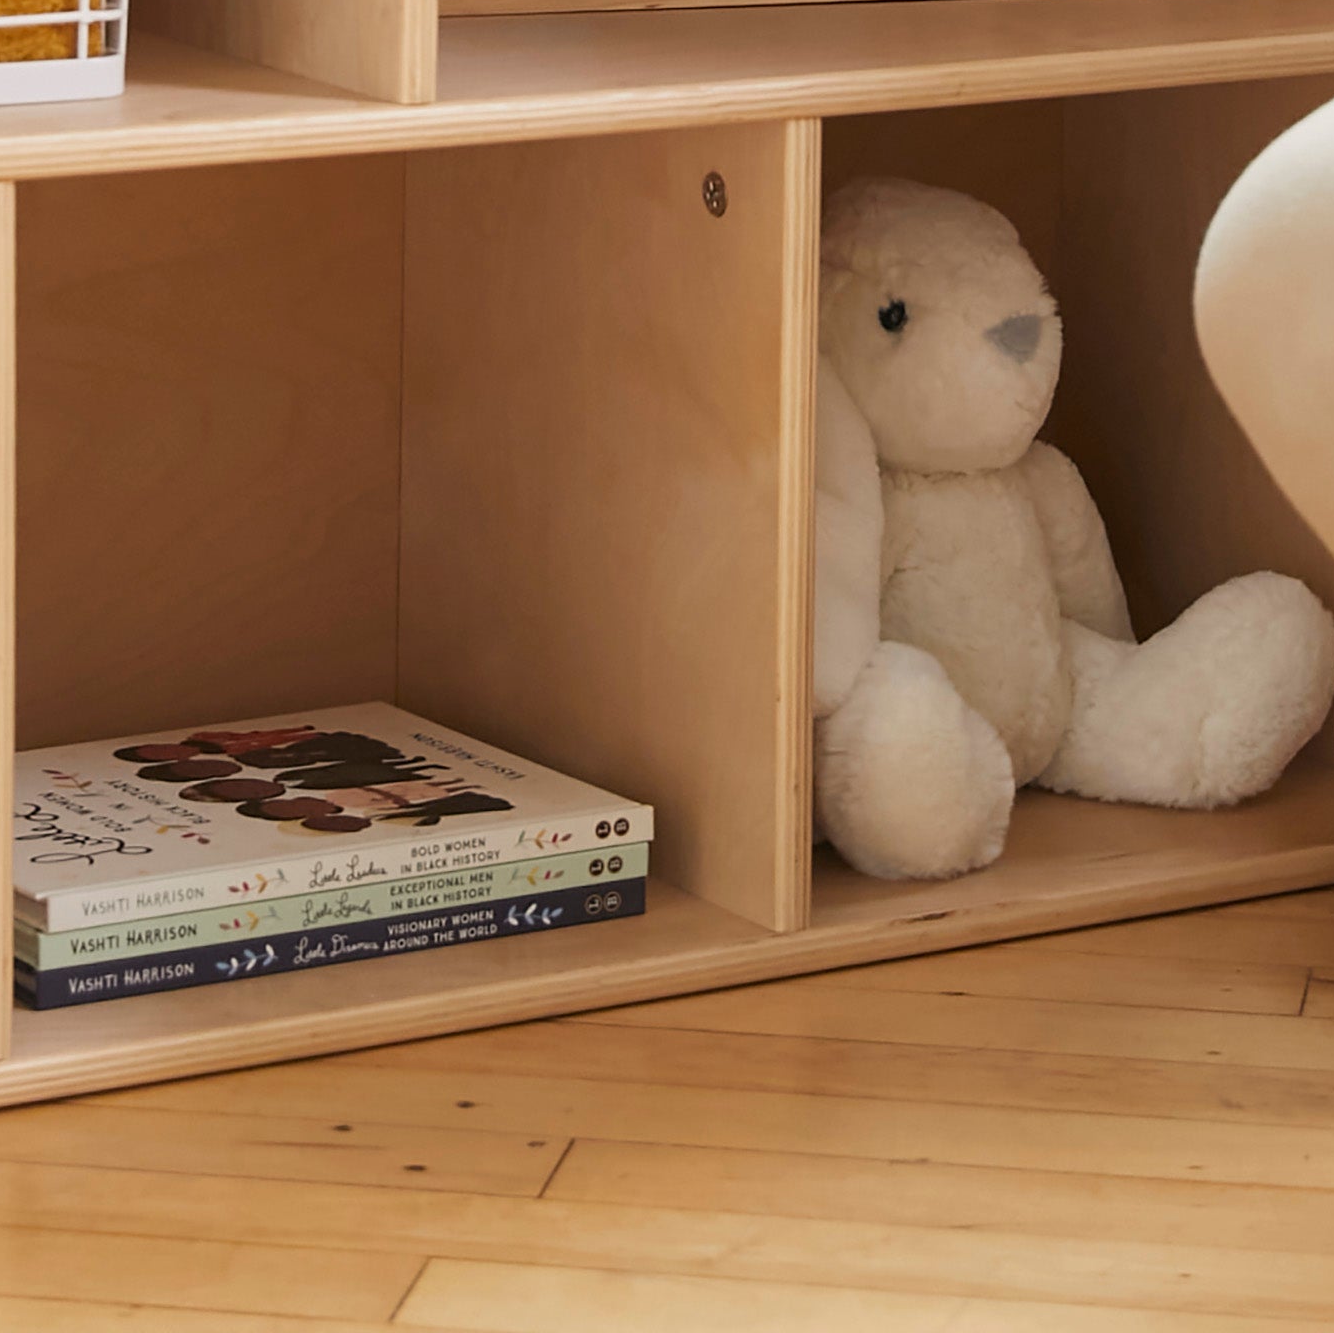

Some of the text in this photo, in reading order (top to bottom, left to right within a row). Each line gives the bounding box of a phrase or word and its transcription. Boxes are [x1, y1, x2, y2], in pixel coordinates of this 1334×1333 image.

[411, 837, 486, 858] BOLD WOMEN
[401, 850, 501, 874] IN BLACK HISTORY
[390, 871, 493, 896] EXCEPTIONAL MEN
[82, 887, 205, 917] VASHTI HARRISON
[391, 886, 492, 910] IN BLACK HISTORY
[387, 909, 494, 936] VISIONARY WOMEN
[70, 924, 197, 955] VASHTI HARRISON
[383, 924, 498, 952] AROUND THE WORLD
[69, 963, 195, 994] VASHTI HARRISON
